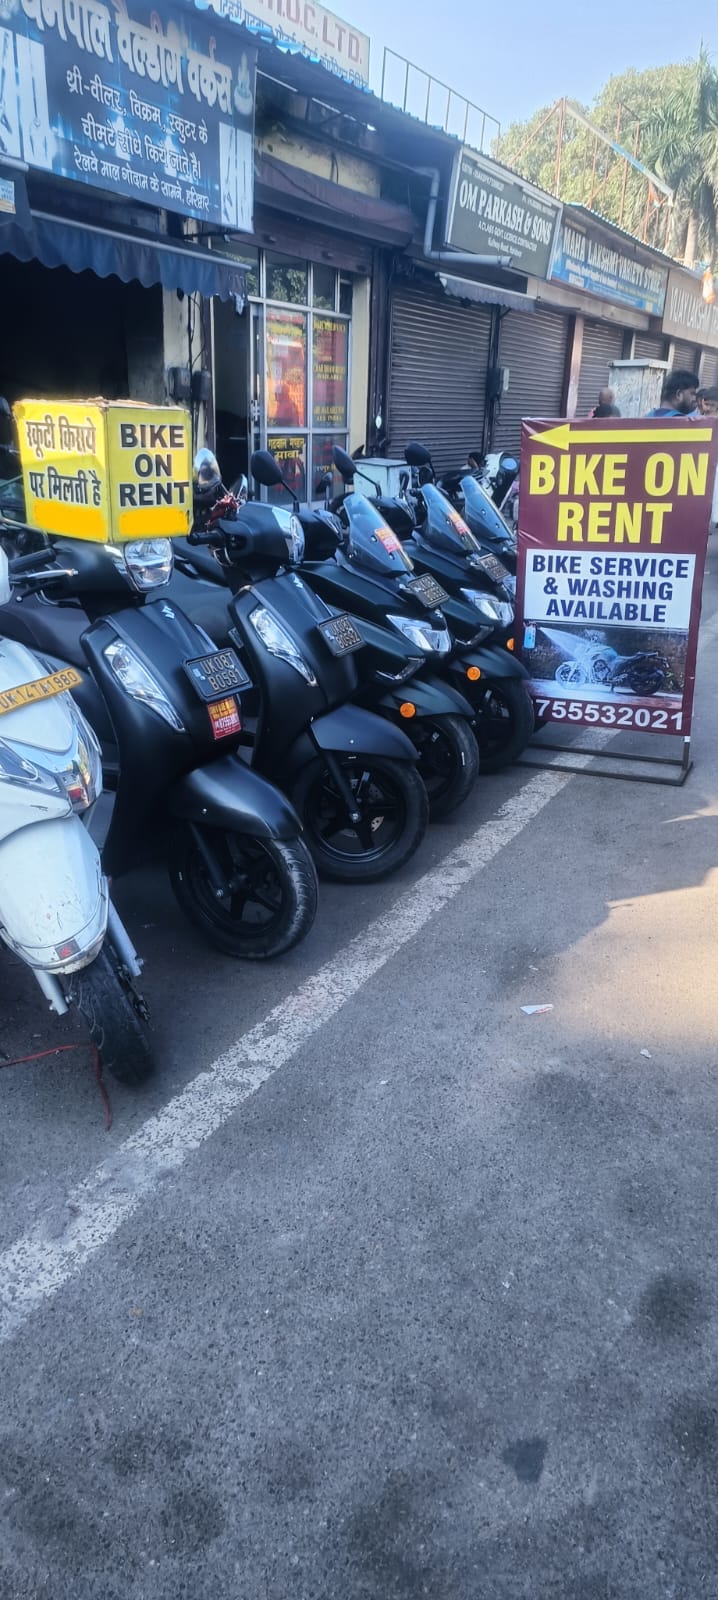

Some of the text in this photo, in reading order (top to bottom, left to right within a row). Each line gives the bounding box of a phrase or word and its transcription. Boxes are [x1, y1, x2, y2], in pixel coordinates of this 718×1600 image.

[322, 15, 362, 65] LTD.
[198, 119, 208, 144] के
[149, 171, 160, 193] के
[459, 179, 479, 212] OM
[478, 188, 525, 233] PARKASH
[523, 211, 533, 236] &
[531, 215, 553, 246] SONS
[562, 226, 586, 262] MAHA
[587, 239, 619, 277] LAKSHMI
[120, 423, 185, 448] BIKE
[134, 453, 173, 478] ON
[529, 452, 709, 497] BIKE ON
[29, 466, 102, 507] पर मिलती है
[119, 482, 190, 507] RENT
[557, 502, 672, 544] RENT
[532, 554, 582, 574] BIKE
[589, 556, 690, 579] SERVICE
[543, 577, 673, 600] & WASHING
[546, 598, 667, 623] AVAILABLE
[199, 652, 235, 675] UK08T
[207, 668, 245, 691] B0591
[530, 697, 684, 731] 755532021
